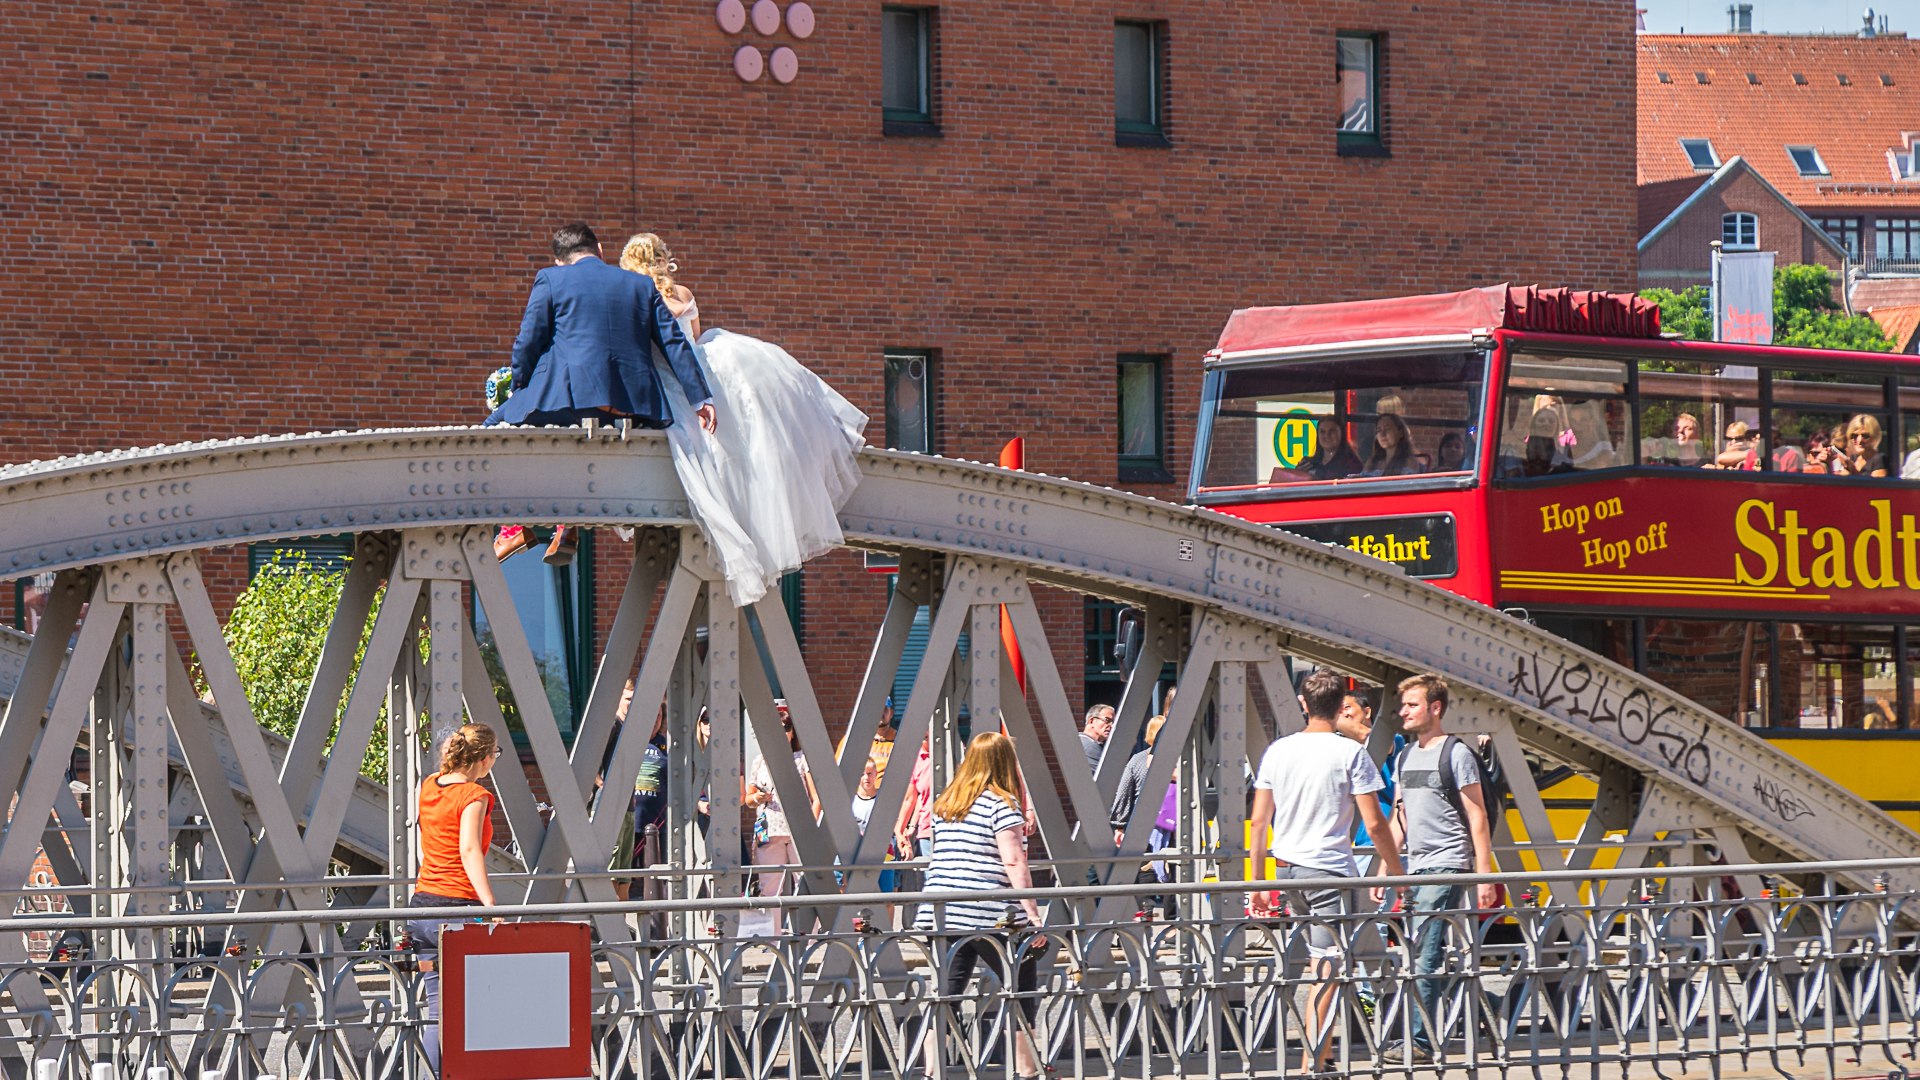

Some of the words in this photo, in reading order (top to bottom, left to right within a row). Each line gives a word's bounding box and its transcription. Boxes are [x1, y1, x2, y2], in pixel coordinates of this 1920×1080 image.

[1286, 423, 1309, 457] H
[1540, 503, 1590, 534] Hop
[1595, 497, 1623, 520] on
[1581, 537, 1631, 569] Hop
[1635, 521, 1668, 554] off
[1735, 499, 1920, 590] Stadt
